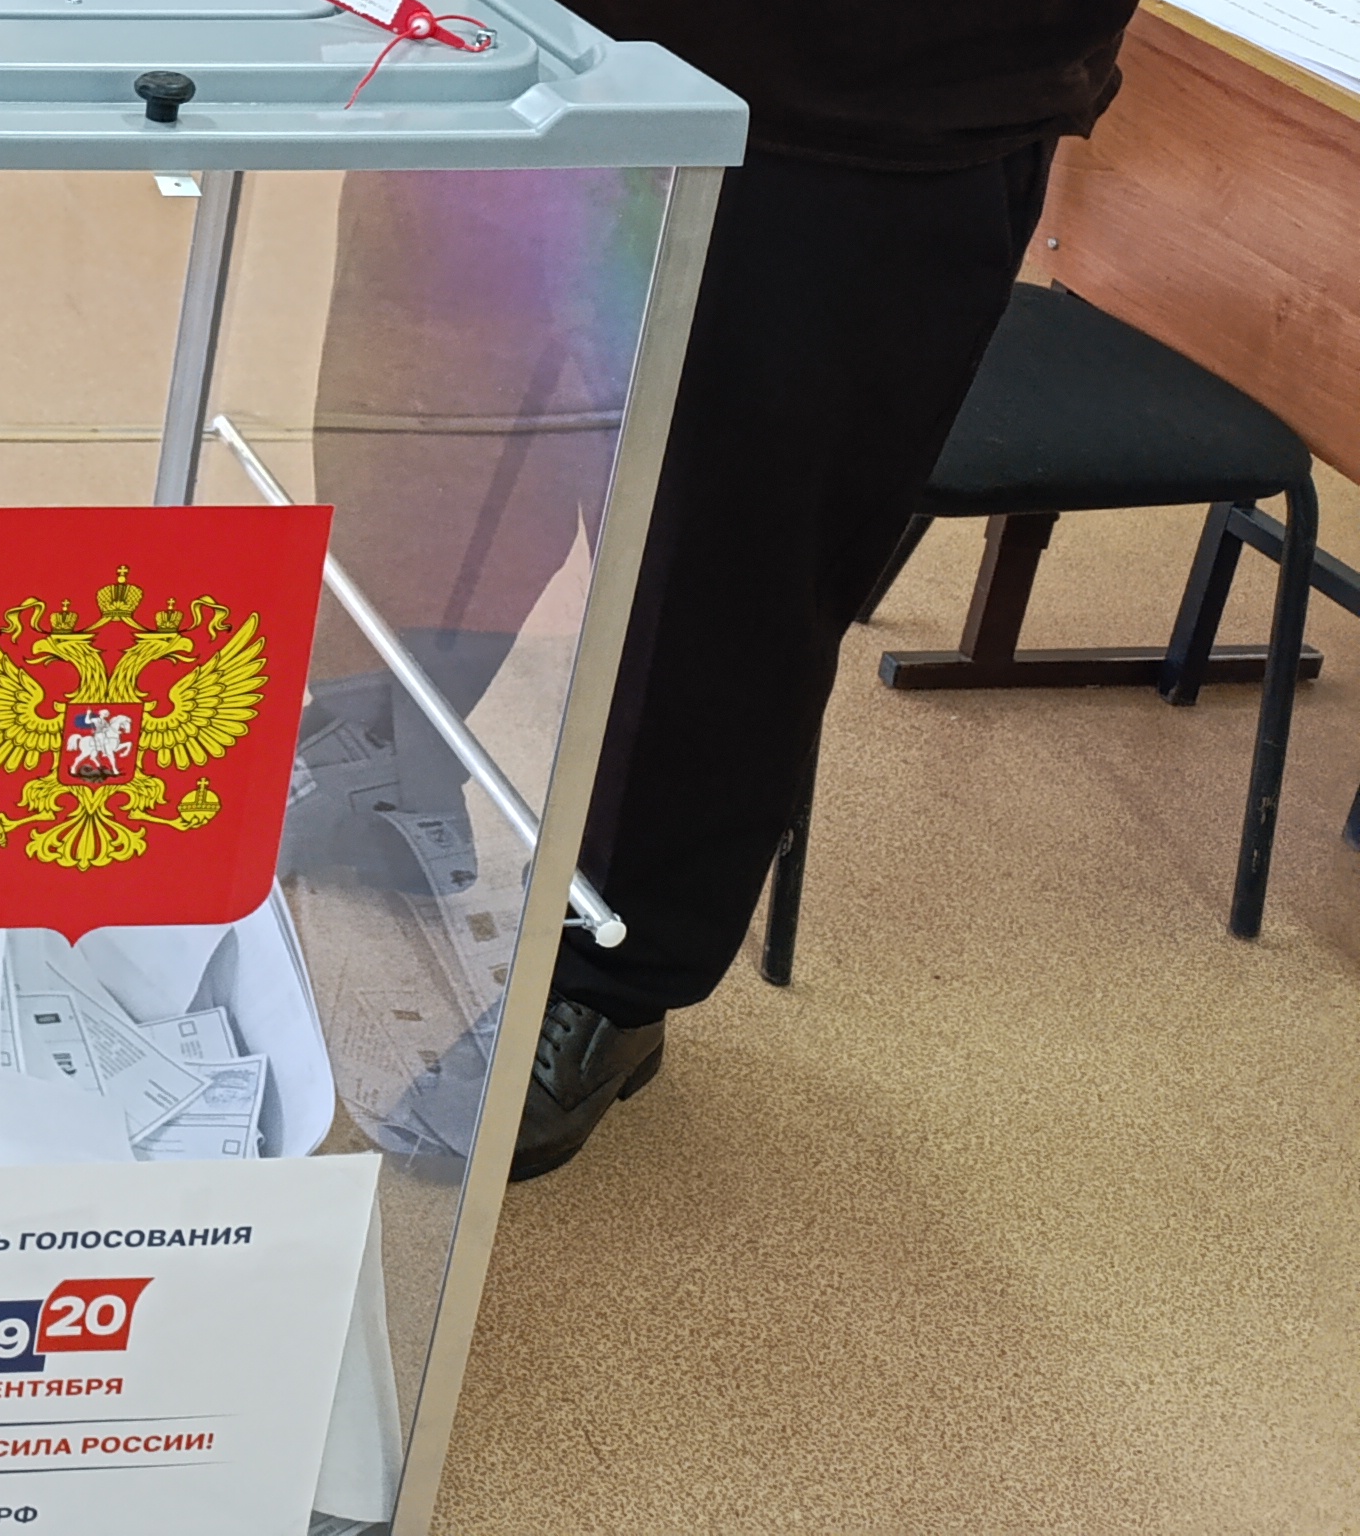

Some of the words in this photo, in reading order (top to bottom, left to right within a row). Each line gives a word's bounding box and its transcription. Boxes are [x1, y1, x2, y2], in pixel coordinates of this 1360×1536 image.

[20, 1227, 252, 1250] ГОЛОСОВАНИЯ
[46, 1295, 126, 1336] 20
[82, 1433, 213, 1454] РОССИИ!
